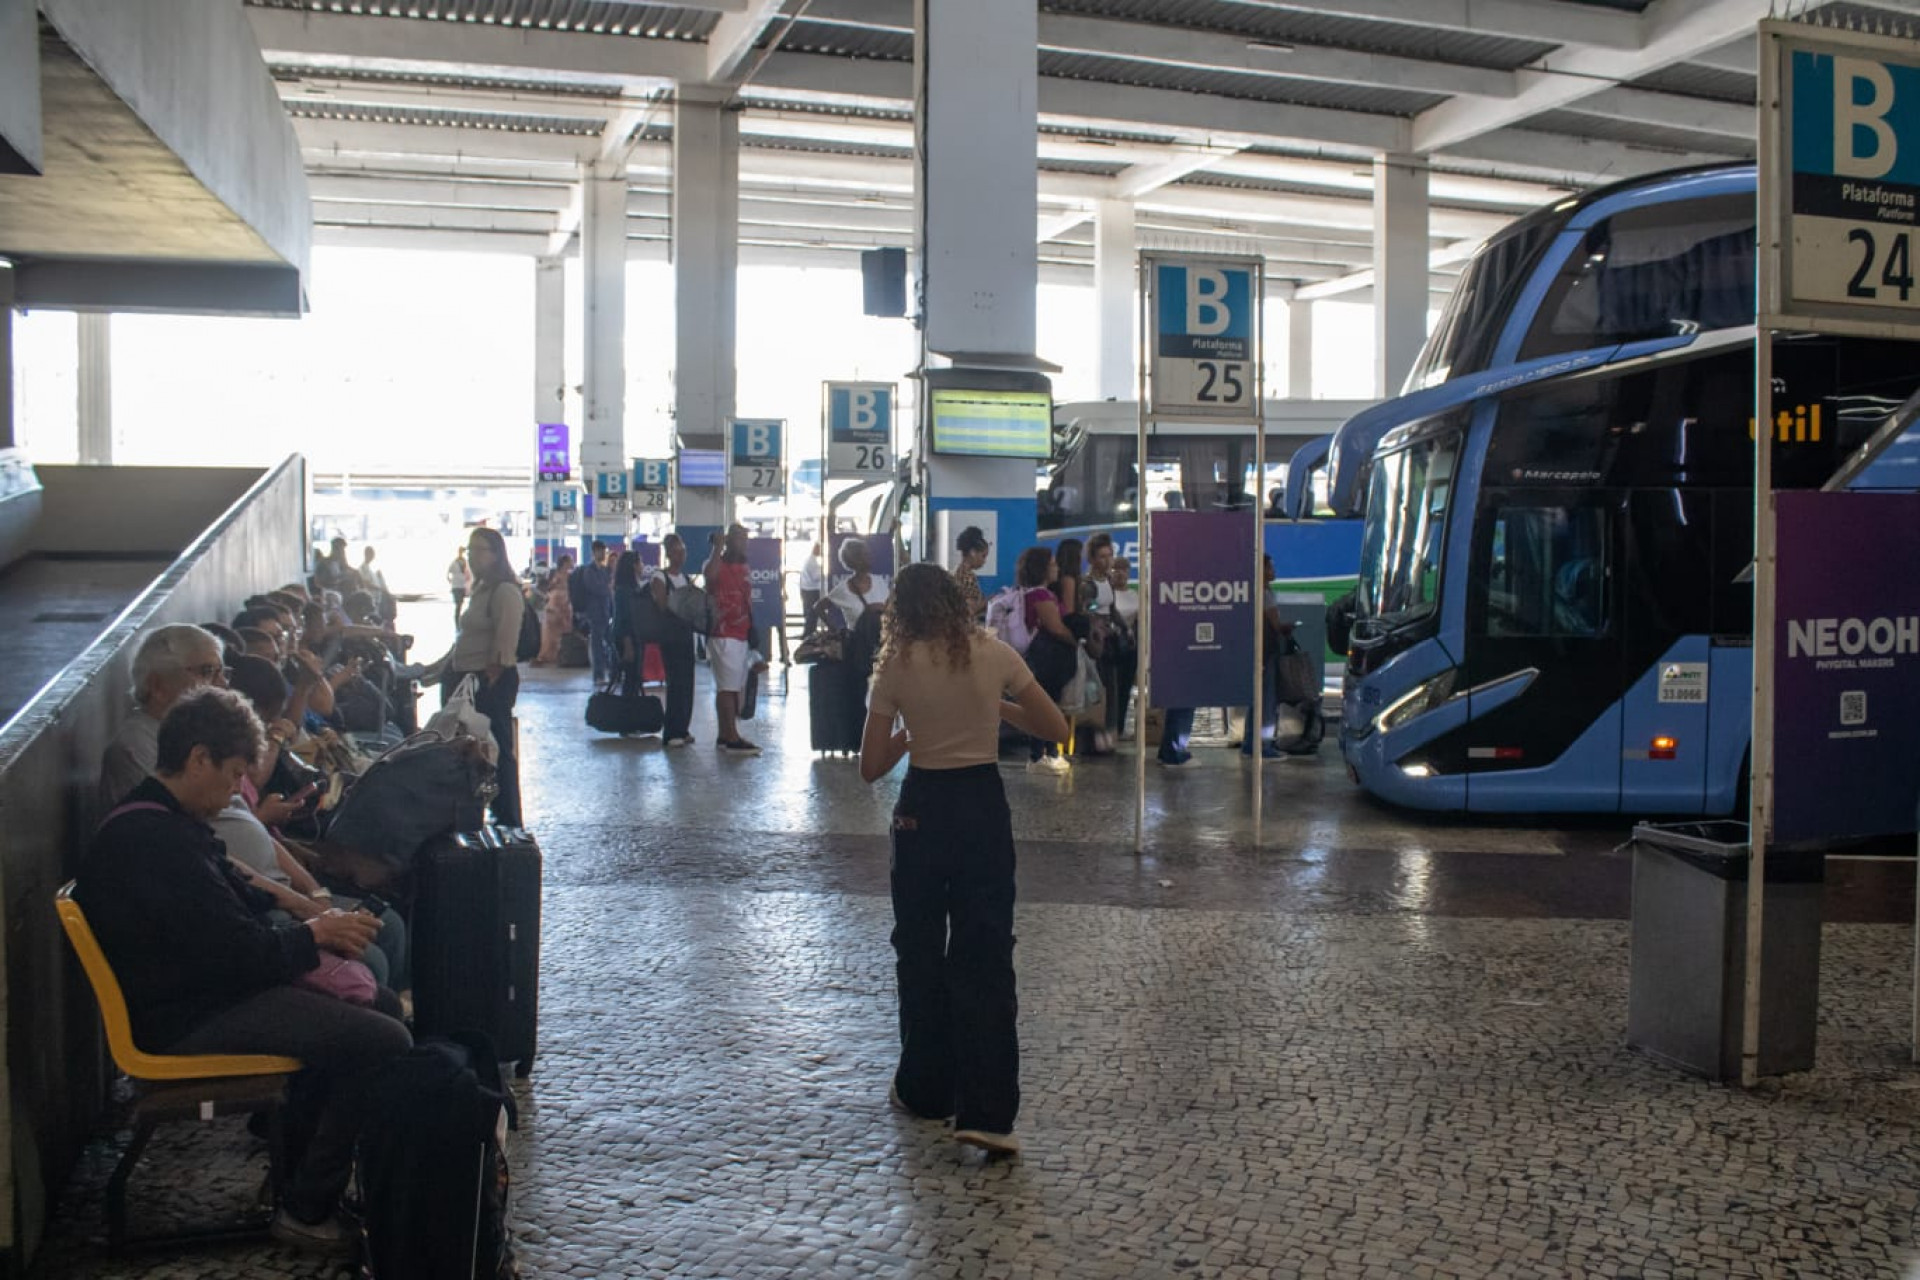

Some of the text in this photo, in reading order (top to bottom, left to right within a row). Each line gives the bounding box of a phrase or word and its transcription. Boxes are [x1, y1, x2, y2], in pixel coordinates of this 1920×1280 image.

[1833, 55, 1898, 179] B
[1842, 183, 1914, 208] Plataforma
[1847, 227, 1914, 302] 24
[1186, 265, 1231, 336] B
[1192, 338, 1243, 352] Plataforma
[1197, 361, 1243, 404] 25
[849, 389, 877, 430] B
[748, 425, 770, 456] B
[855, 445, 885, 470] 26
[607, 472, 621, 494] B
[644, 461, 661, 485] B
[752, 469, 776, 488] 27
[1525, 469, 1601, 481] Marcopolo
[560, 491, 571, 506] B
[611, 501, 626, 512] 29
[646, 493, 665, 506] 28
[1158, 581, 1249, 605] NEOOH
[1787, 616, 1919, 658] NEOOH
